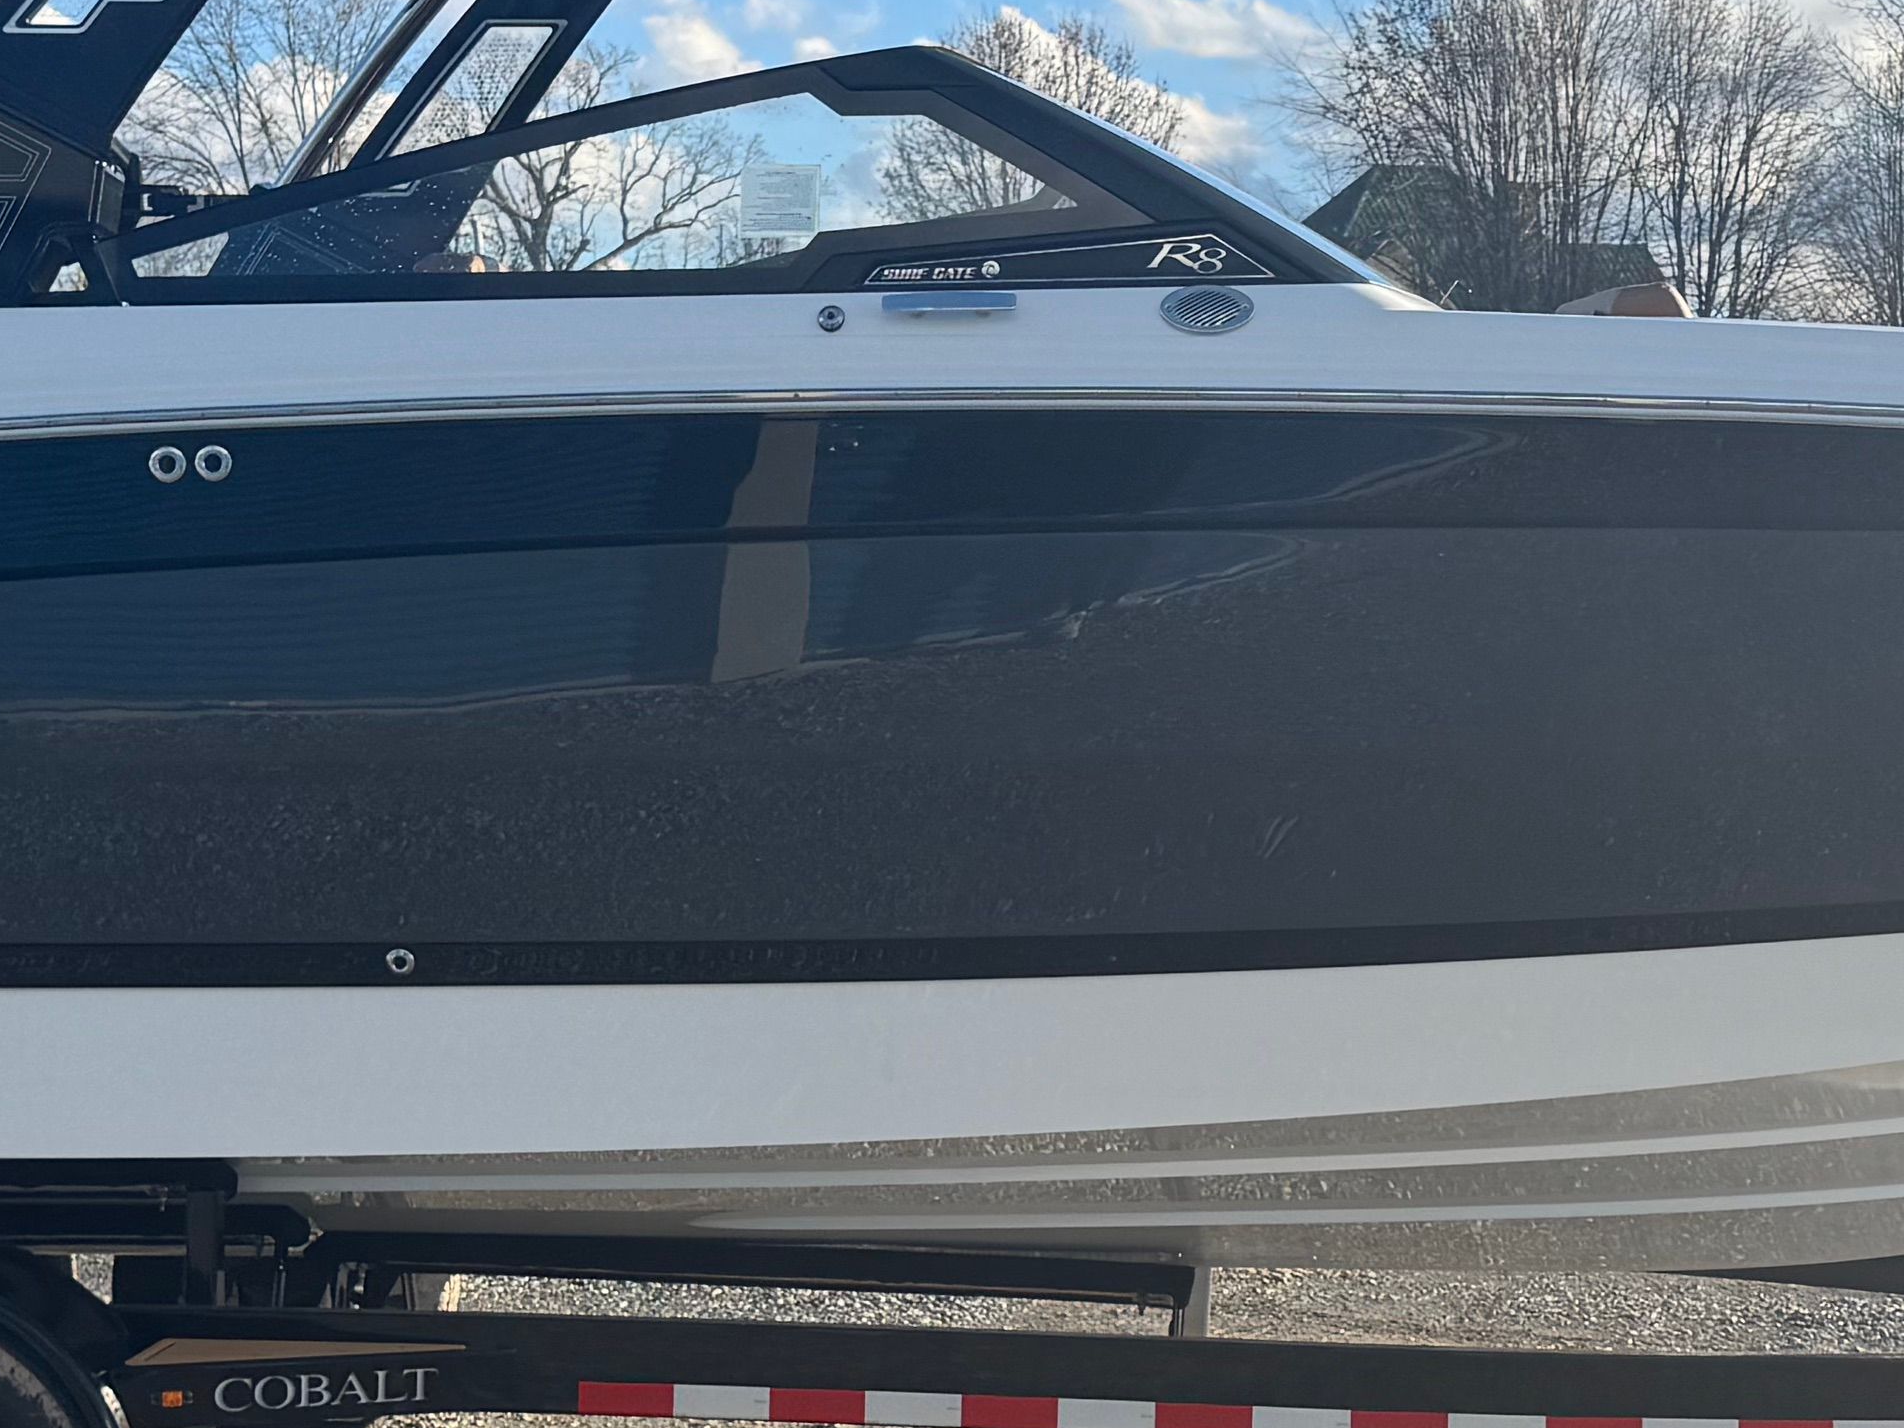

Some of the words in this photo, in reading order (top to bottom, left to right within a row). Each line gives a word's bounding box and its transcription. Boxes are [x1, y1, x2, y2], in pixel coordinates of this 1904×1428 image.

[932, 266, 978, 279] GATE
[1146, 242, 1227, 274] R8
[213, 1367, 440, 1413] COBALT
